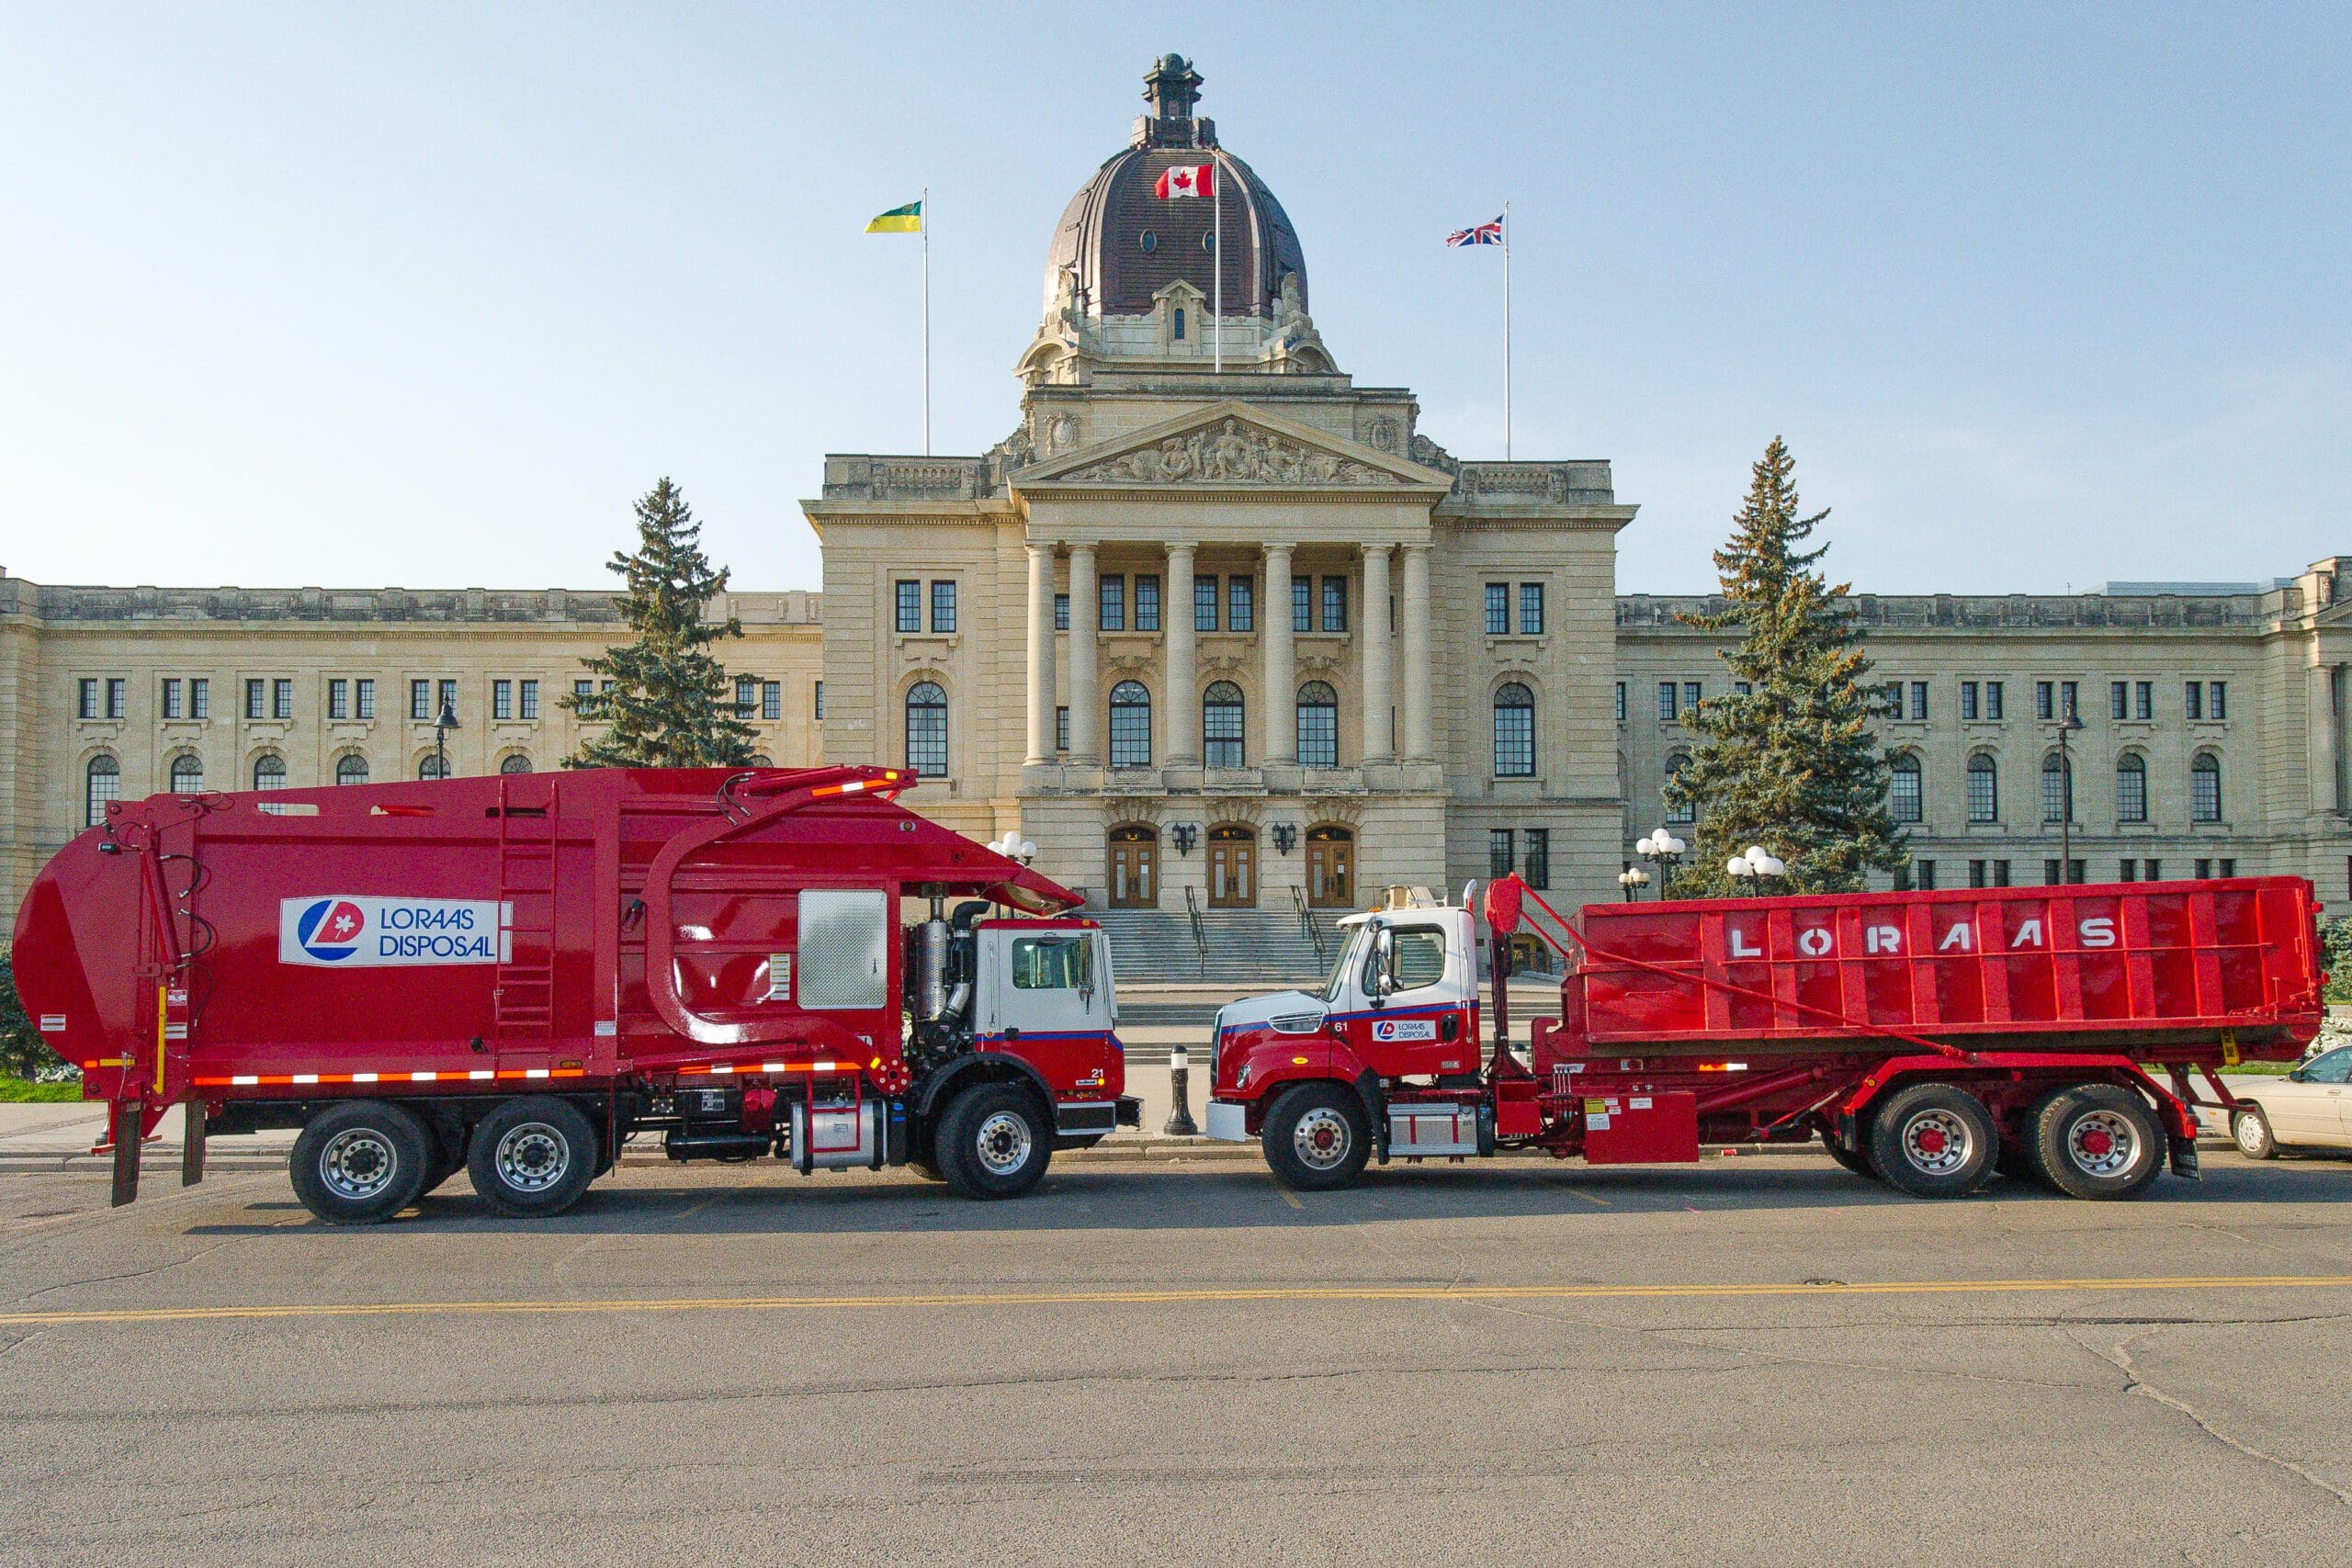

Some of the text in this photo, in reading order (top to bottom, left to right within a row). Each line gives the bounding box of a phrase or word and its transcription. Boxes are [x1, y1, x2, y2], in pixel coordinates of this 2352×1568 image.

[380, 908, 474, 930] LORAAS
[1732, 918, 2116, 957] LORAAS
[379, 935, 495, 957] DISPOSAL
[1334, 1021, 1348, 1032] 61
[1398, 1022, 1426, 1031] LORAAS
[1398, 1031, 1431, 1039] DISPOSAL
[1091, 1068, 1103, 1078] 21
